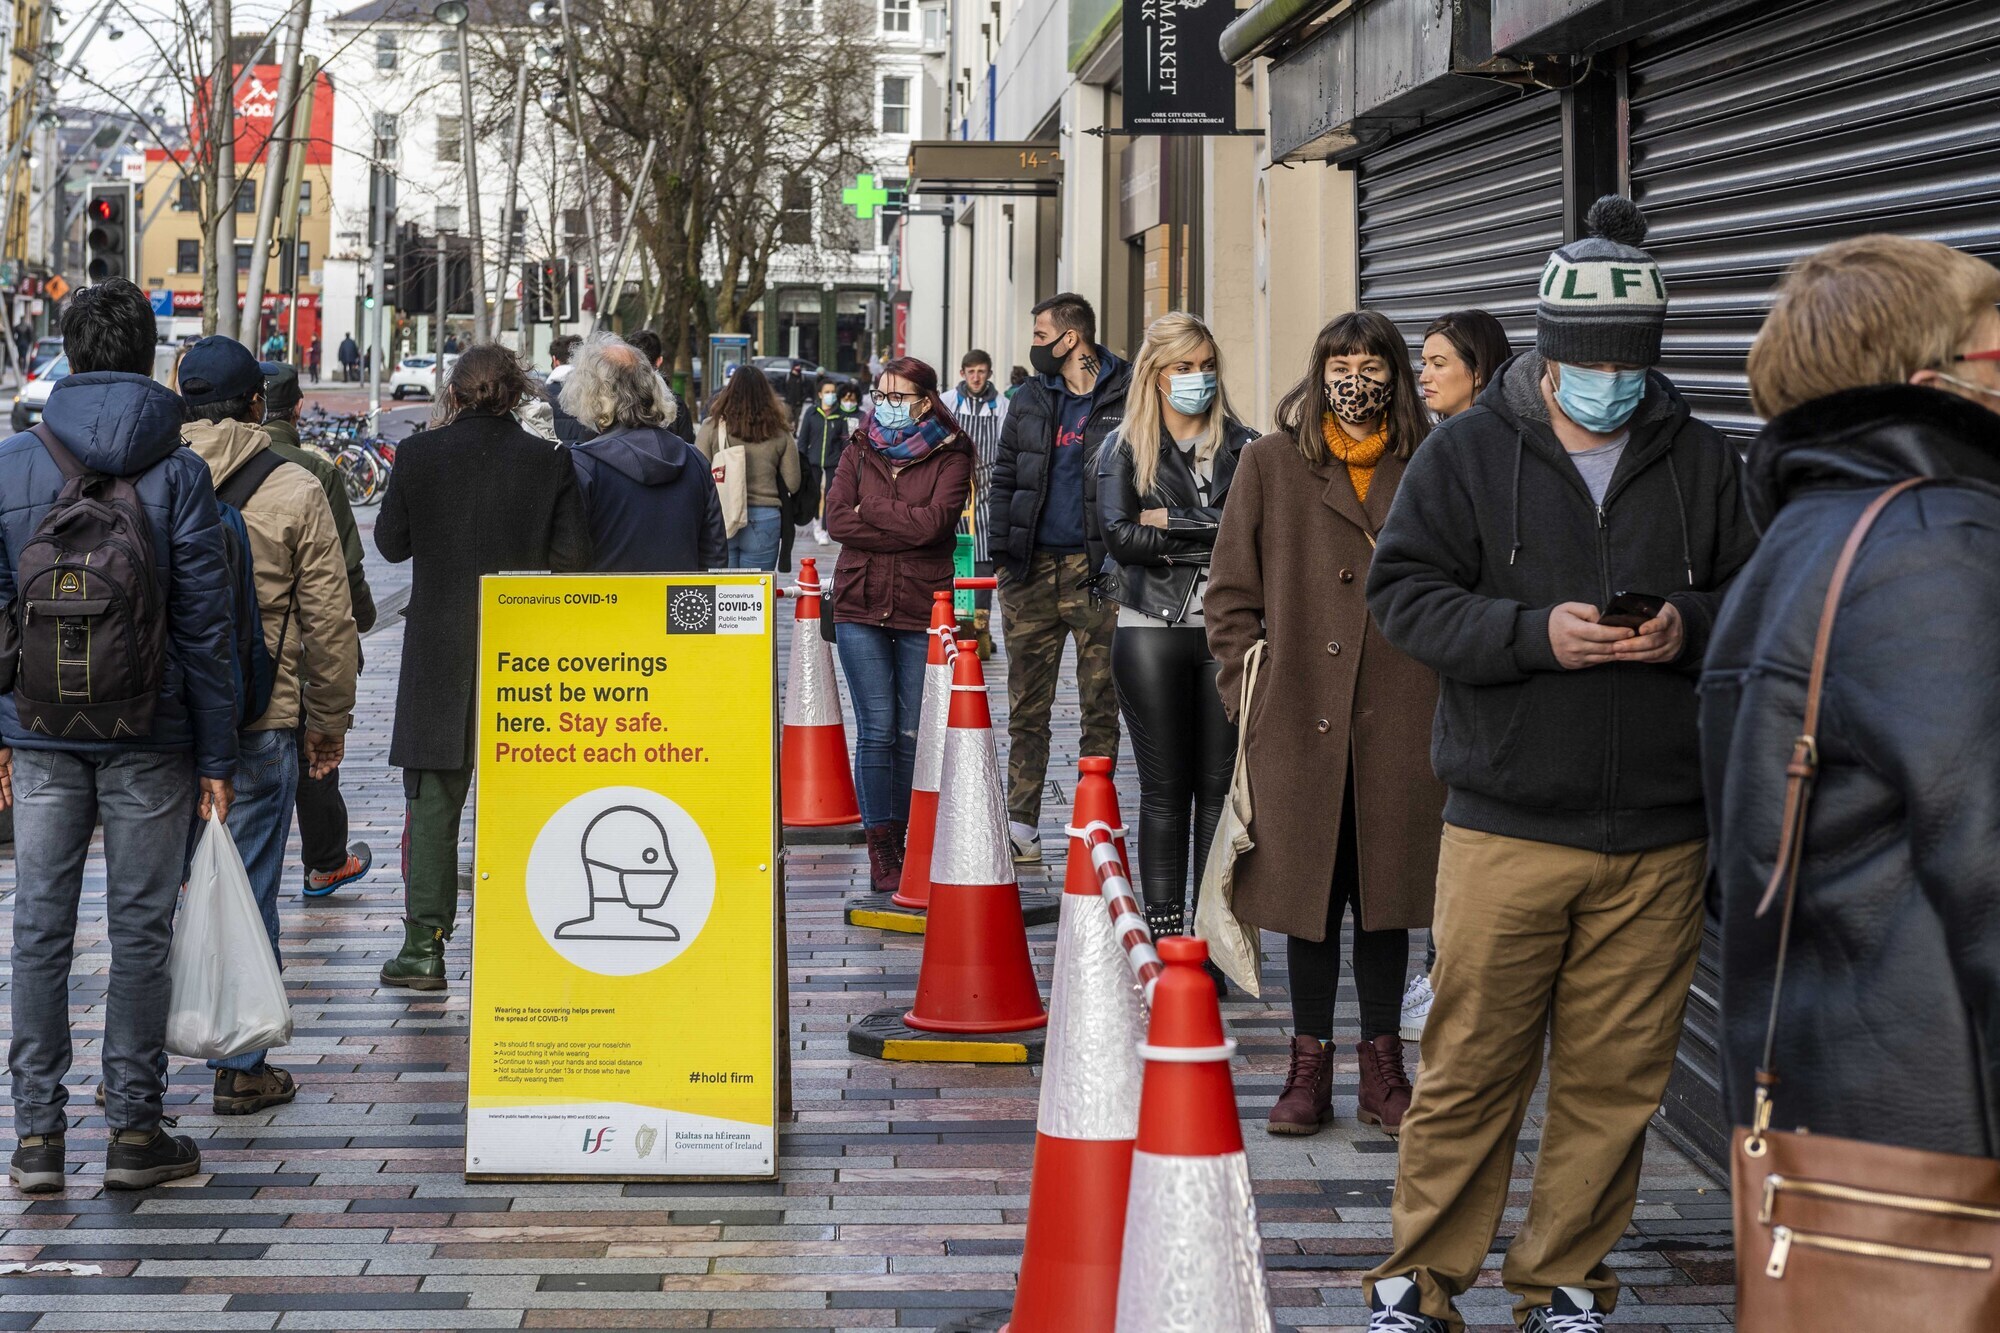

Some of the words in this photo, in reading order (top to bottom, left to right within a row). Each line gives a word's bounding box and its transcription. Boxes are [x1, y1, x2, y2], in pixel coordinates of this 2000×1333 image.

[1159, 0, 1177, 95] MARKET
[498, 594, 561, 604] Coronavirus
[564, 594, 618, 604] COVID-19
[718, 602, 762, 612] COVID-19
[497, 652, 550, 672] Face
[557, 652, 668, 677] coverings
[496, 683, 553, 702] must
[559, 682, 586, 702] be
[592, 687, 649, 702] worn
[496, 712, 551, 732] here.
[559, 712, 608, 737] Stay
[615, 712, 668, 732] safe.
[495, 742, 577, 763] Protect
[583, 742, 636, 762] each
[644, 742, 709, 762] other.
[494, 1006, 521, 1015] Wearing
[542, 1007, 571, 1015] covering
[571, 1007, 590, 1016] helps
[506, 1015, 528, 1024] spread
[536, 1041, 556, 1050] snugly
[517, 1050, 543, 1058] touching
[498, 1075, 523, 1084] difficulty
[689, 1071, 727, 1083] #hold
[730, 1072, 754, 1083] firm
[582, 1126, 617, 1154] HSE
[675, 1131, 703, 1140] Rialtas
[715, 1131, 751, 1140] hÉireann
[674, 1142, 724, 1150] Government
[724, 1142, 734, 1150] of
[734, 1142, 763, 1150] Ireland
